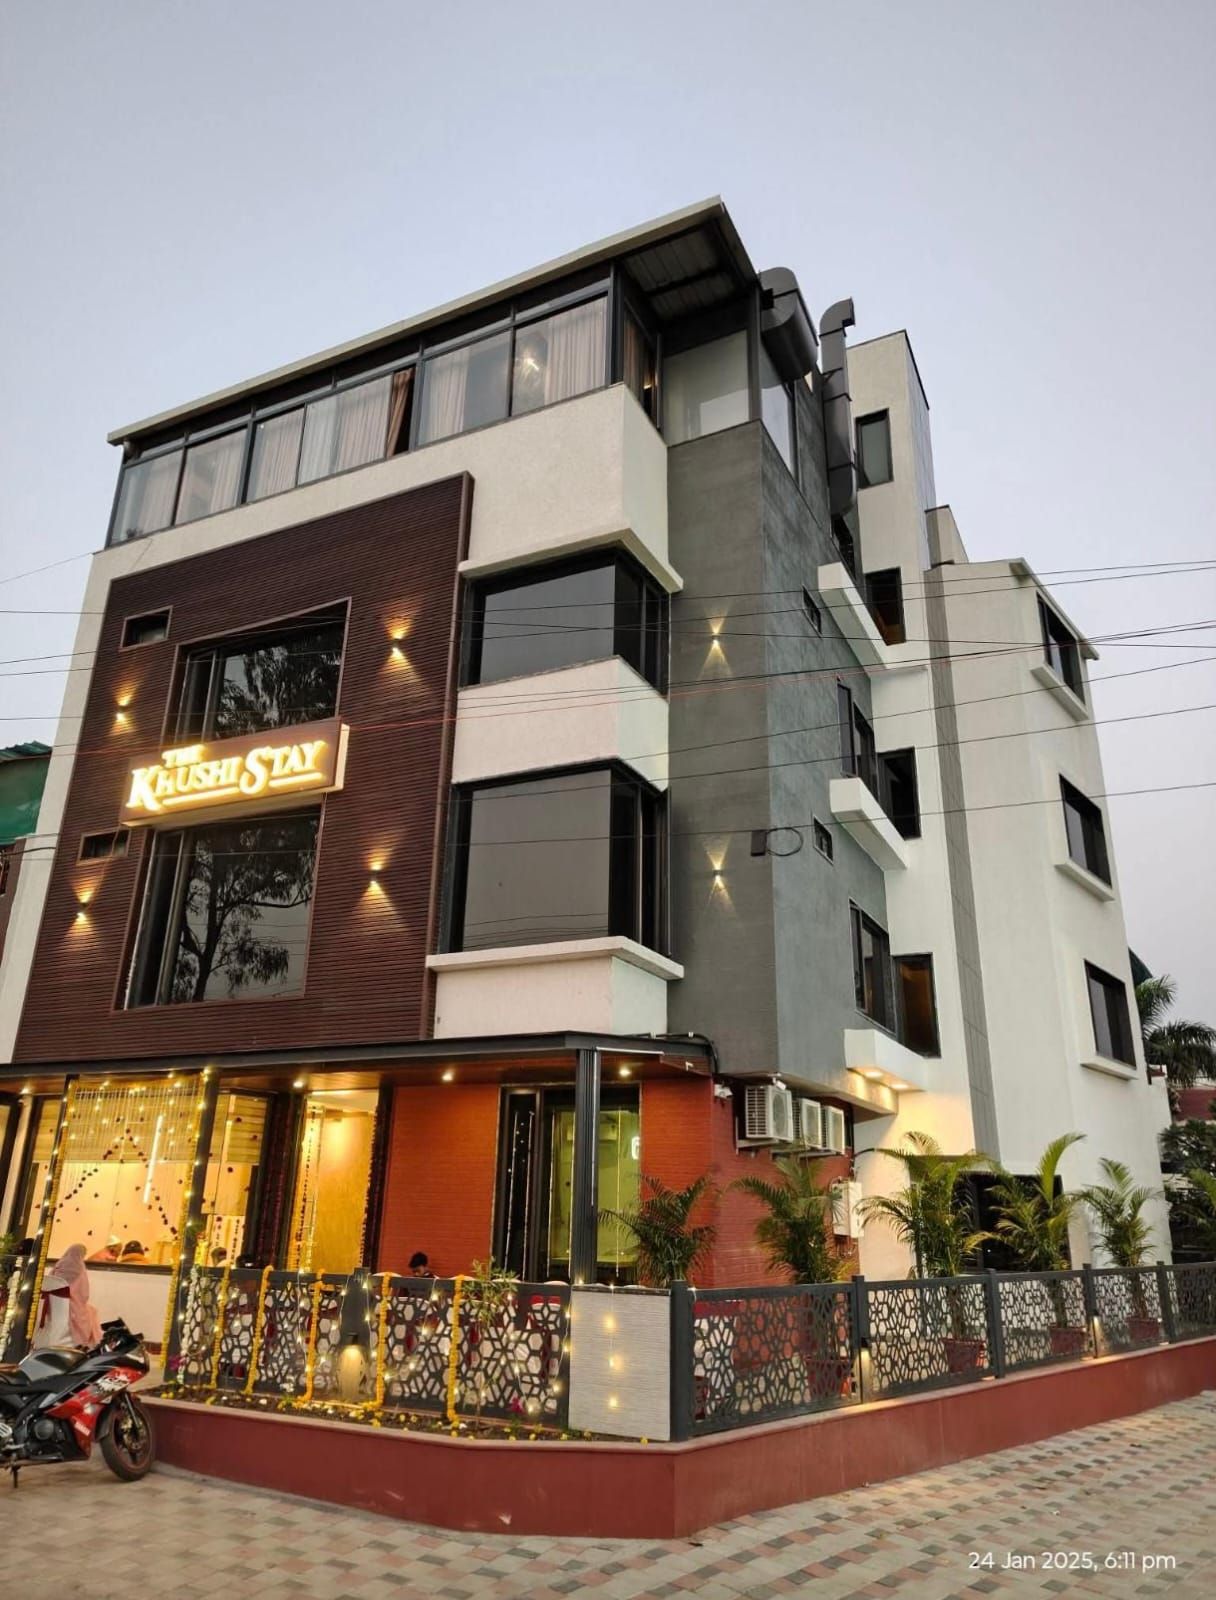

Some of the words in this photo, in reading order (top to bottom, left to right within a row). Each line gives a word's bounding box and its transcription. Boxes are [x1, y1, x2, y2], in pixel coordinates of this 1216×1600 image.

[126, 756, 243, 811] KHUSHI
[239, 740, 326, 795] STAY
[162, 744, 206, 768] THE
